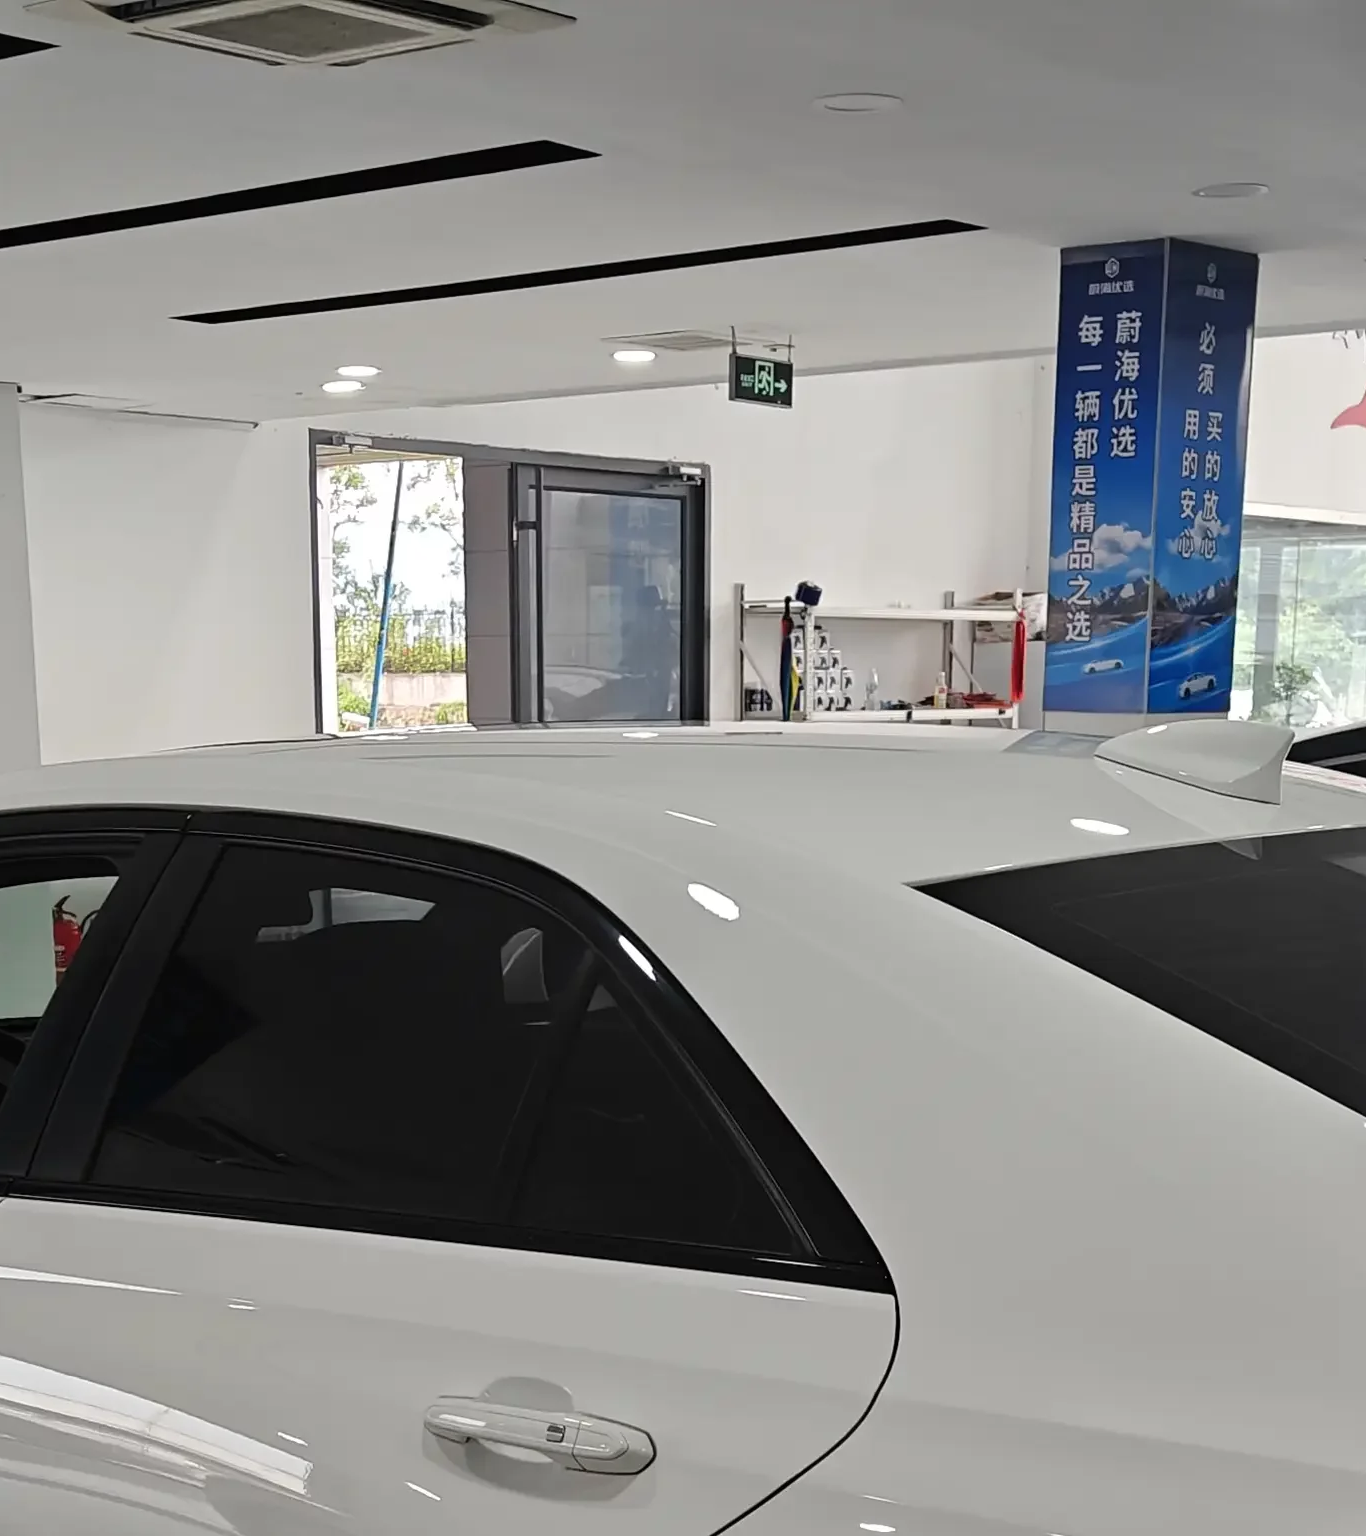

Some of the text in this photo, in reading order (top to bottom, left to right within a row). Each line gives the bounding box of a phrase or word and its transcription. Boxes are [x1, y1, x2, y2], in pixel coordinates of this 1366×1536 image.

[1110, 310, 1142, 458] 蔚海优选
[1197, 321, 1217, 396] 必须
[1065, 314, 1104, 642] 每一辆都是精品之选
[1178, 408, 1200, 559] 用的安心
[1201, 411, 1224, 560] 买的放心
